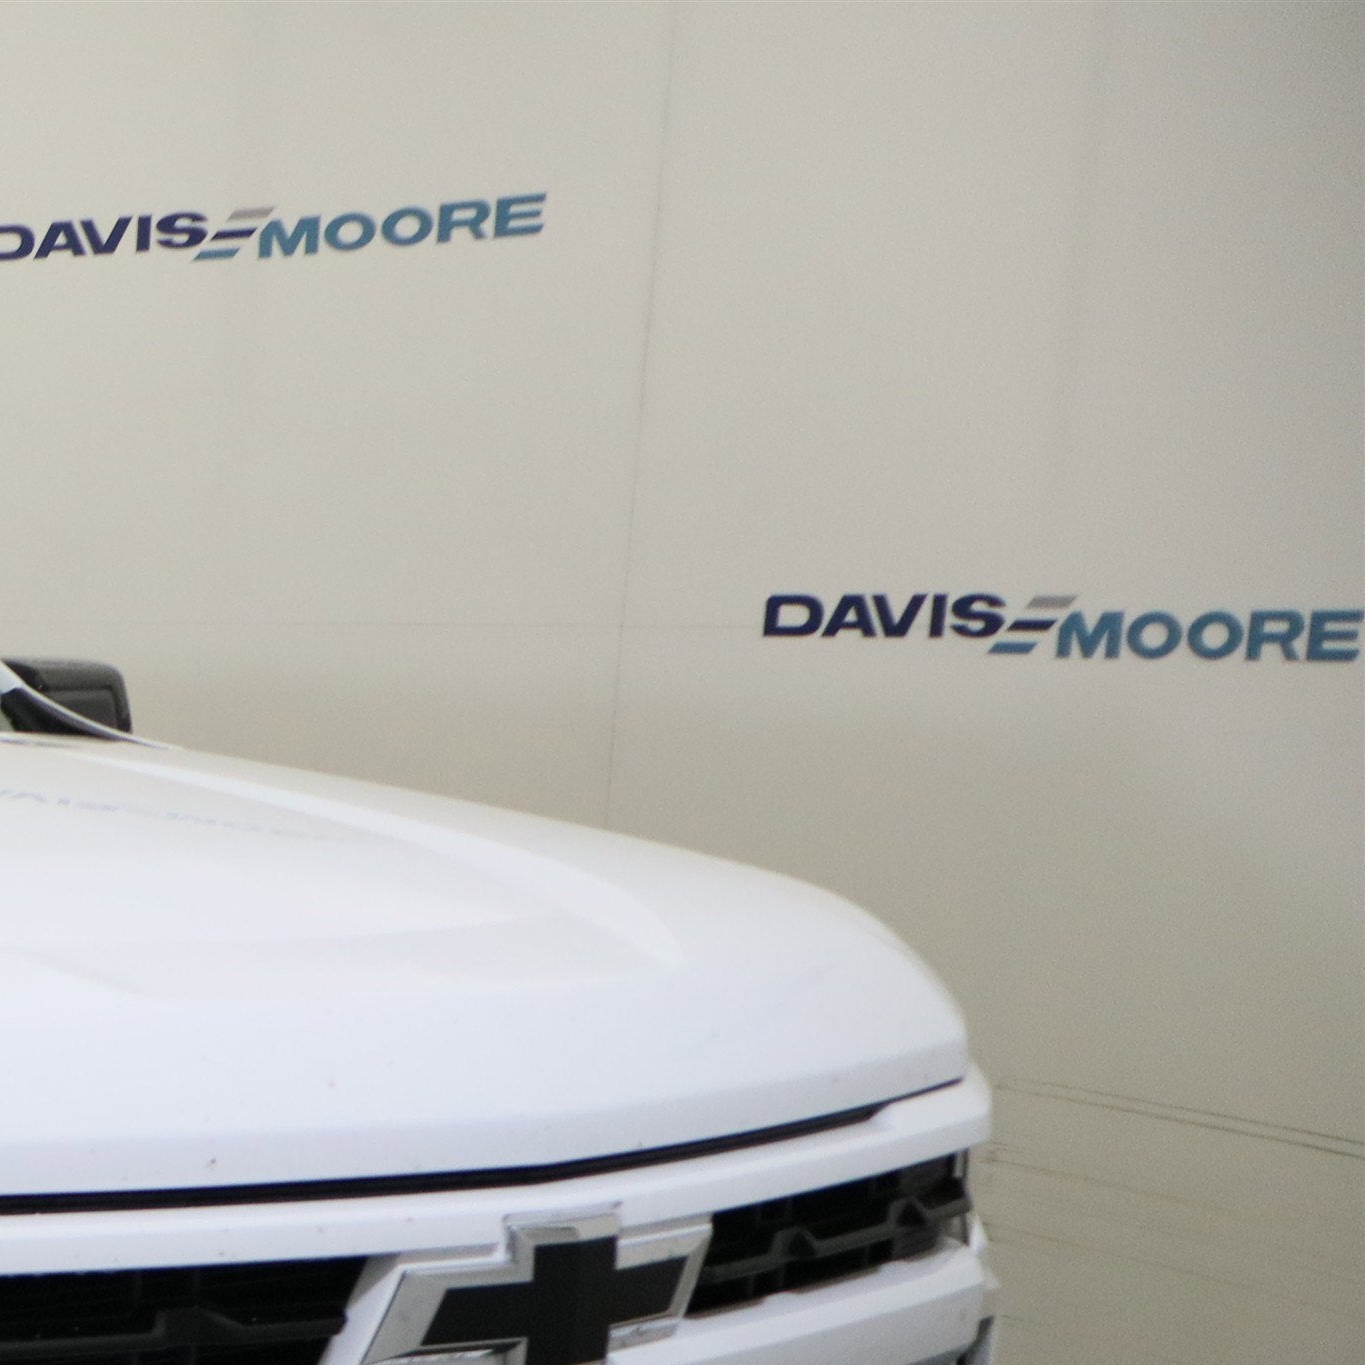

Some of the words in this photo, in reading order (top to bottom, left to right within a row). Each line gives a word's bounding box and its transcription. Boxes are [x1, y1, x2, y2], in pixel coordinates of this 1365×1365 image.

[258, 192, 547, 258] MOORE
[763, 593, 1007, 637] DAVIS
[1055, 609, 1364, 662] MOORE
